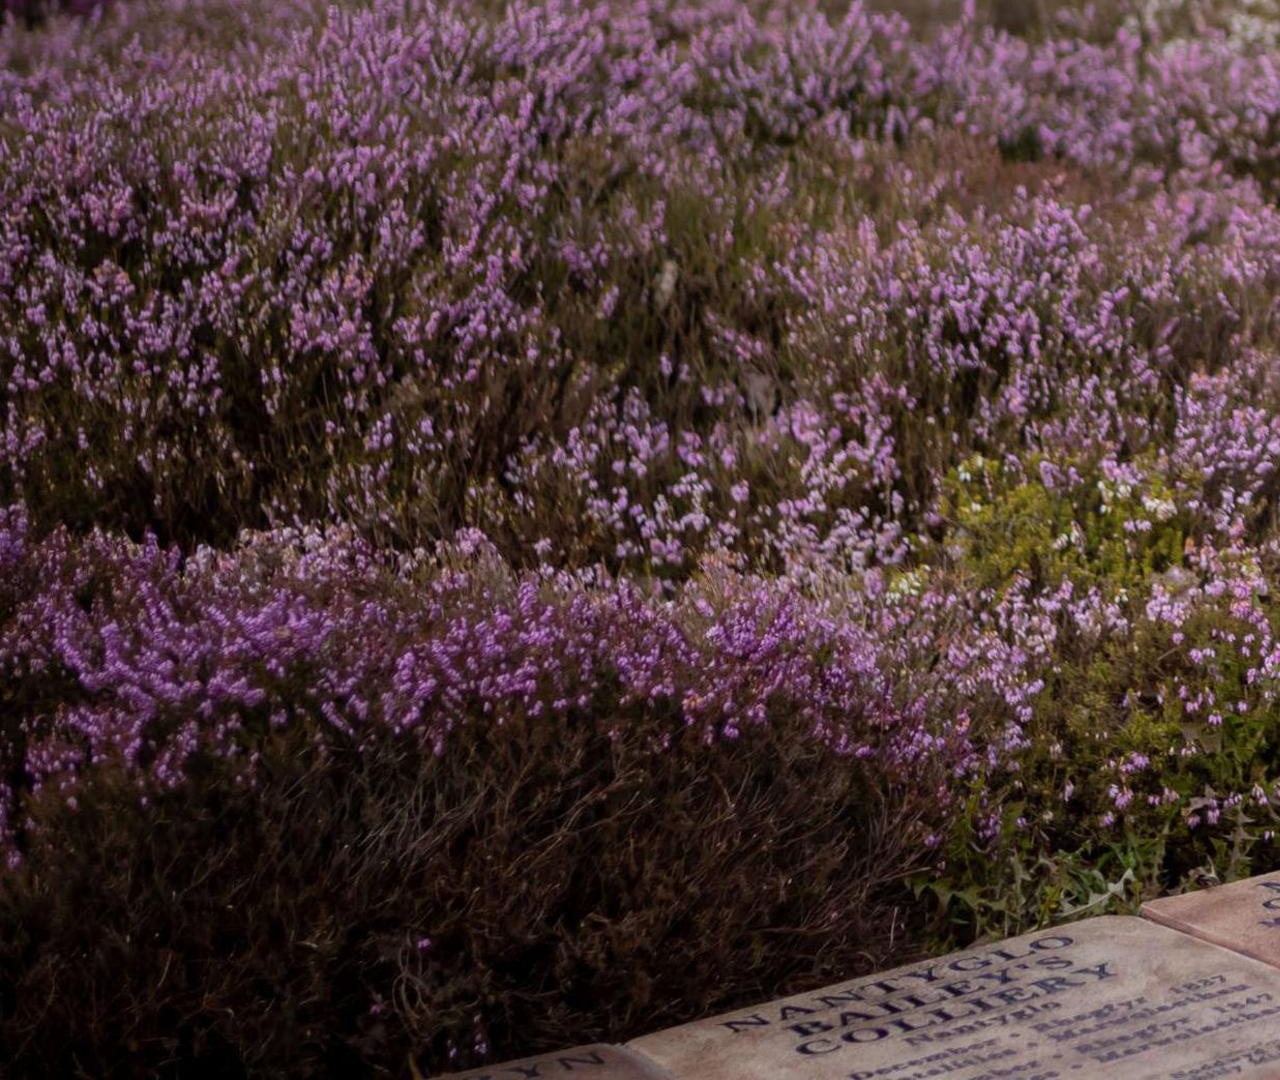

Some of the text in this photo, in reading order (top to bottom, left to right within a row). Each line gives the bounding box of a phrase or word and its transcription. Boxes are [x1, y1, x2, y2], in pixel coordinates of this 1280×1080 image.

[719, 935, 1074, 1035] NANTYGLO
[787, 955, 1075, 1038] BAILEY'S
[795, 960, 1118, 1056] COLLIERY
[903, 1000, 1063, 1047] Nantyglo
